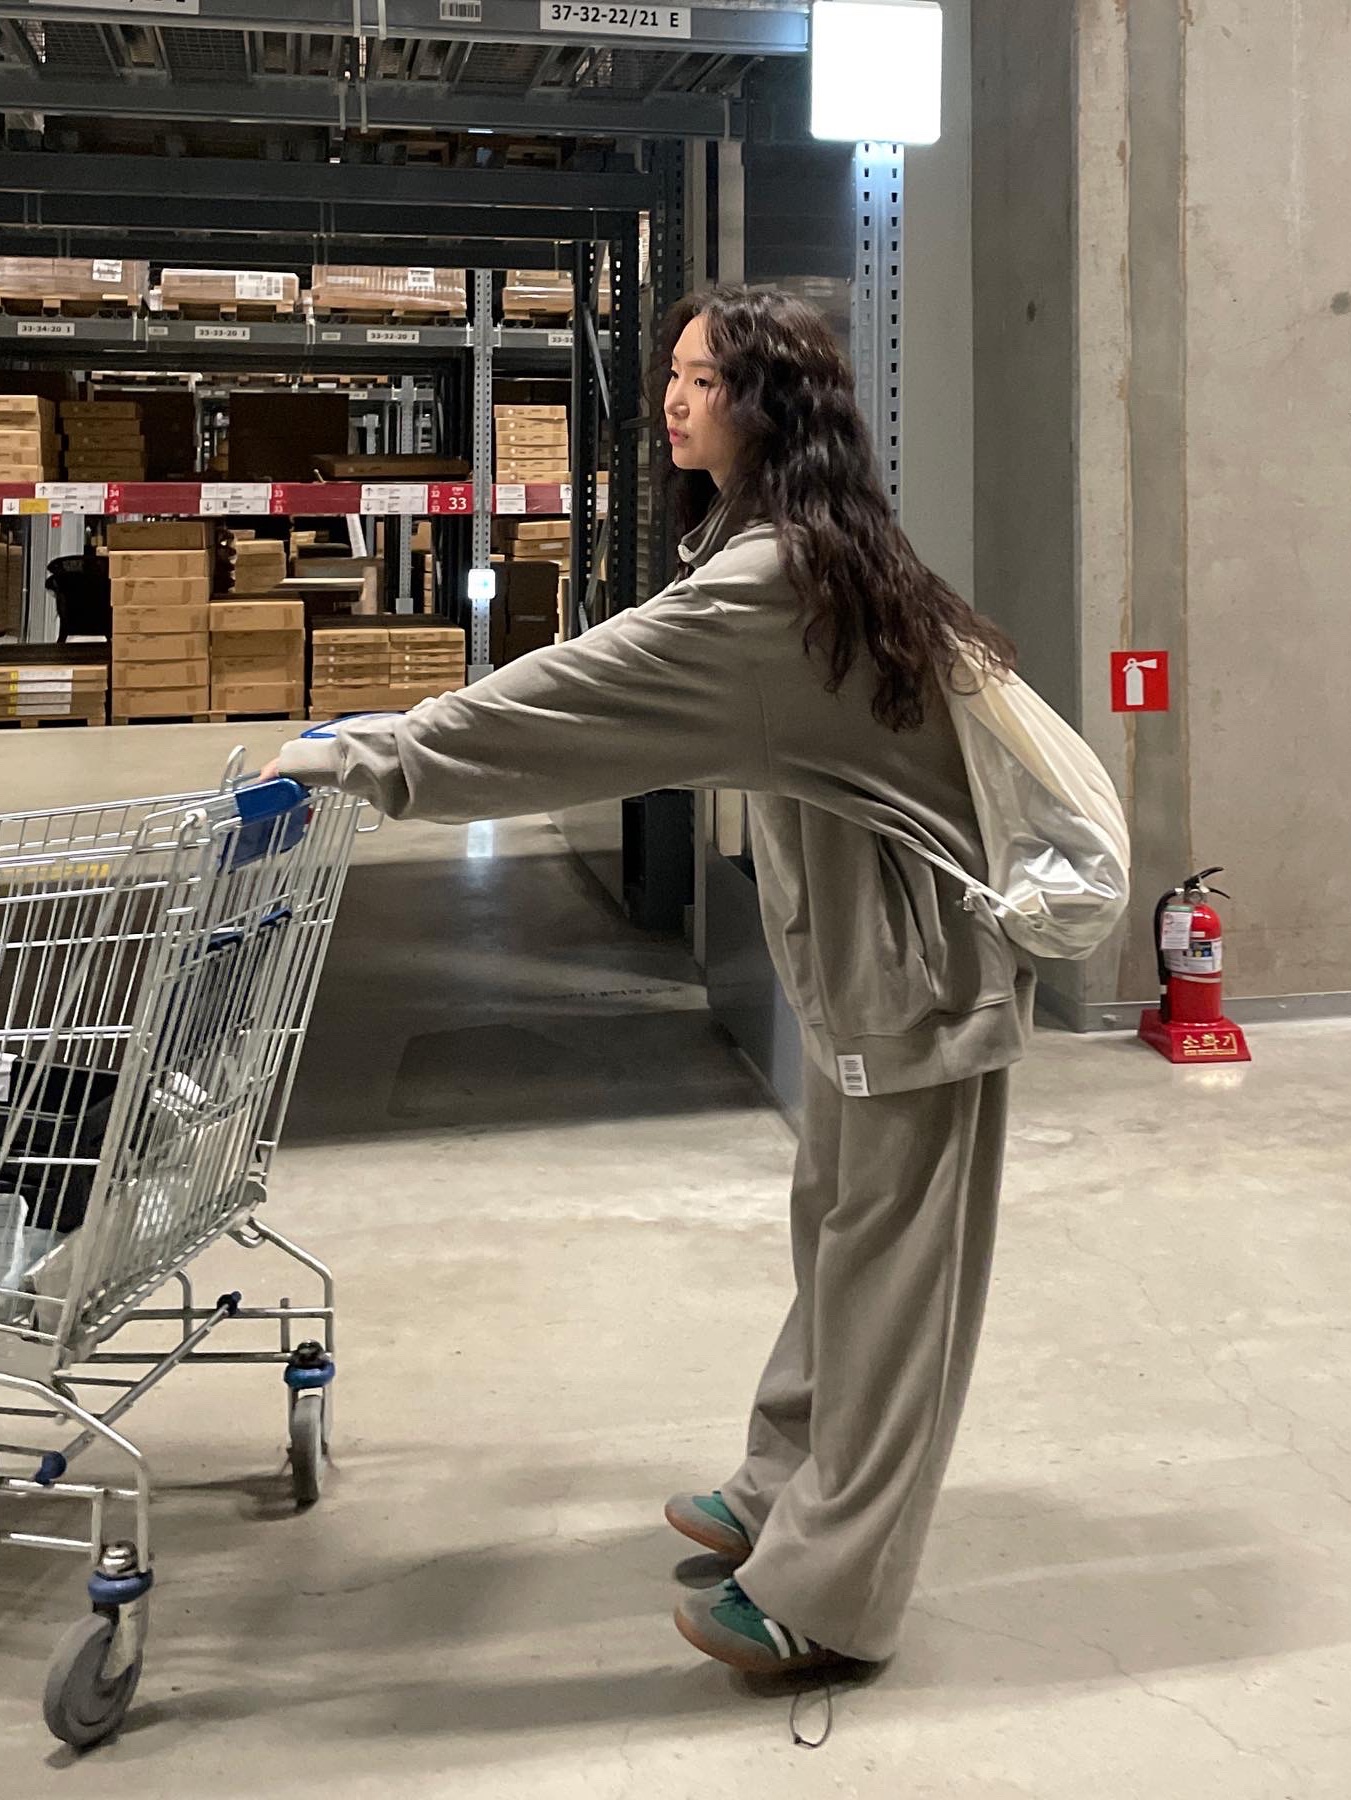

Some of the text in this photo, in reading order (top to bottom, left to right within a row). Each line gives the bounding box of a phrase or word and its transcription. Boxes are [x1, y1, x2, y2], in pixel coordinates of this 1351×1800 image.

[551, 4, 679, 28] 37-32-22/21 E
[447, 496, 468, 511] 33
[1182, 1032, 1238, 1051] 소화기
